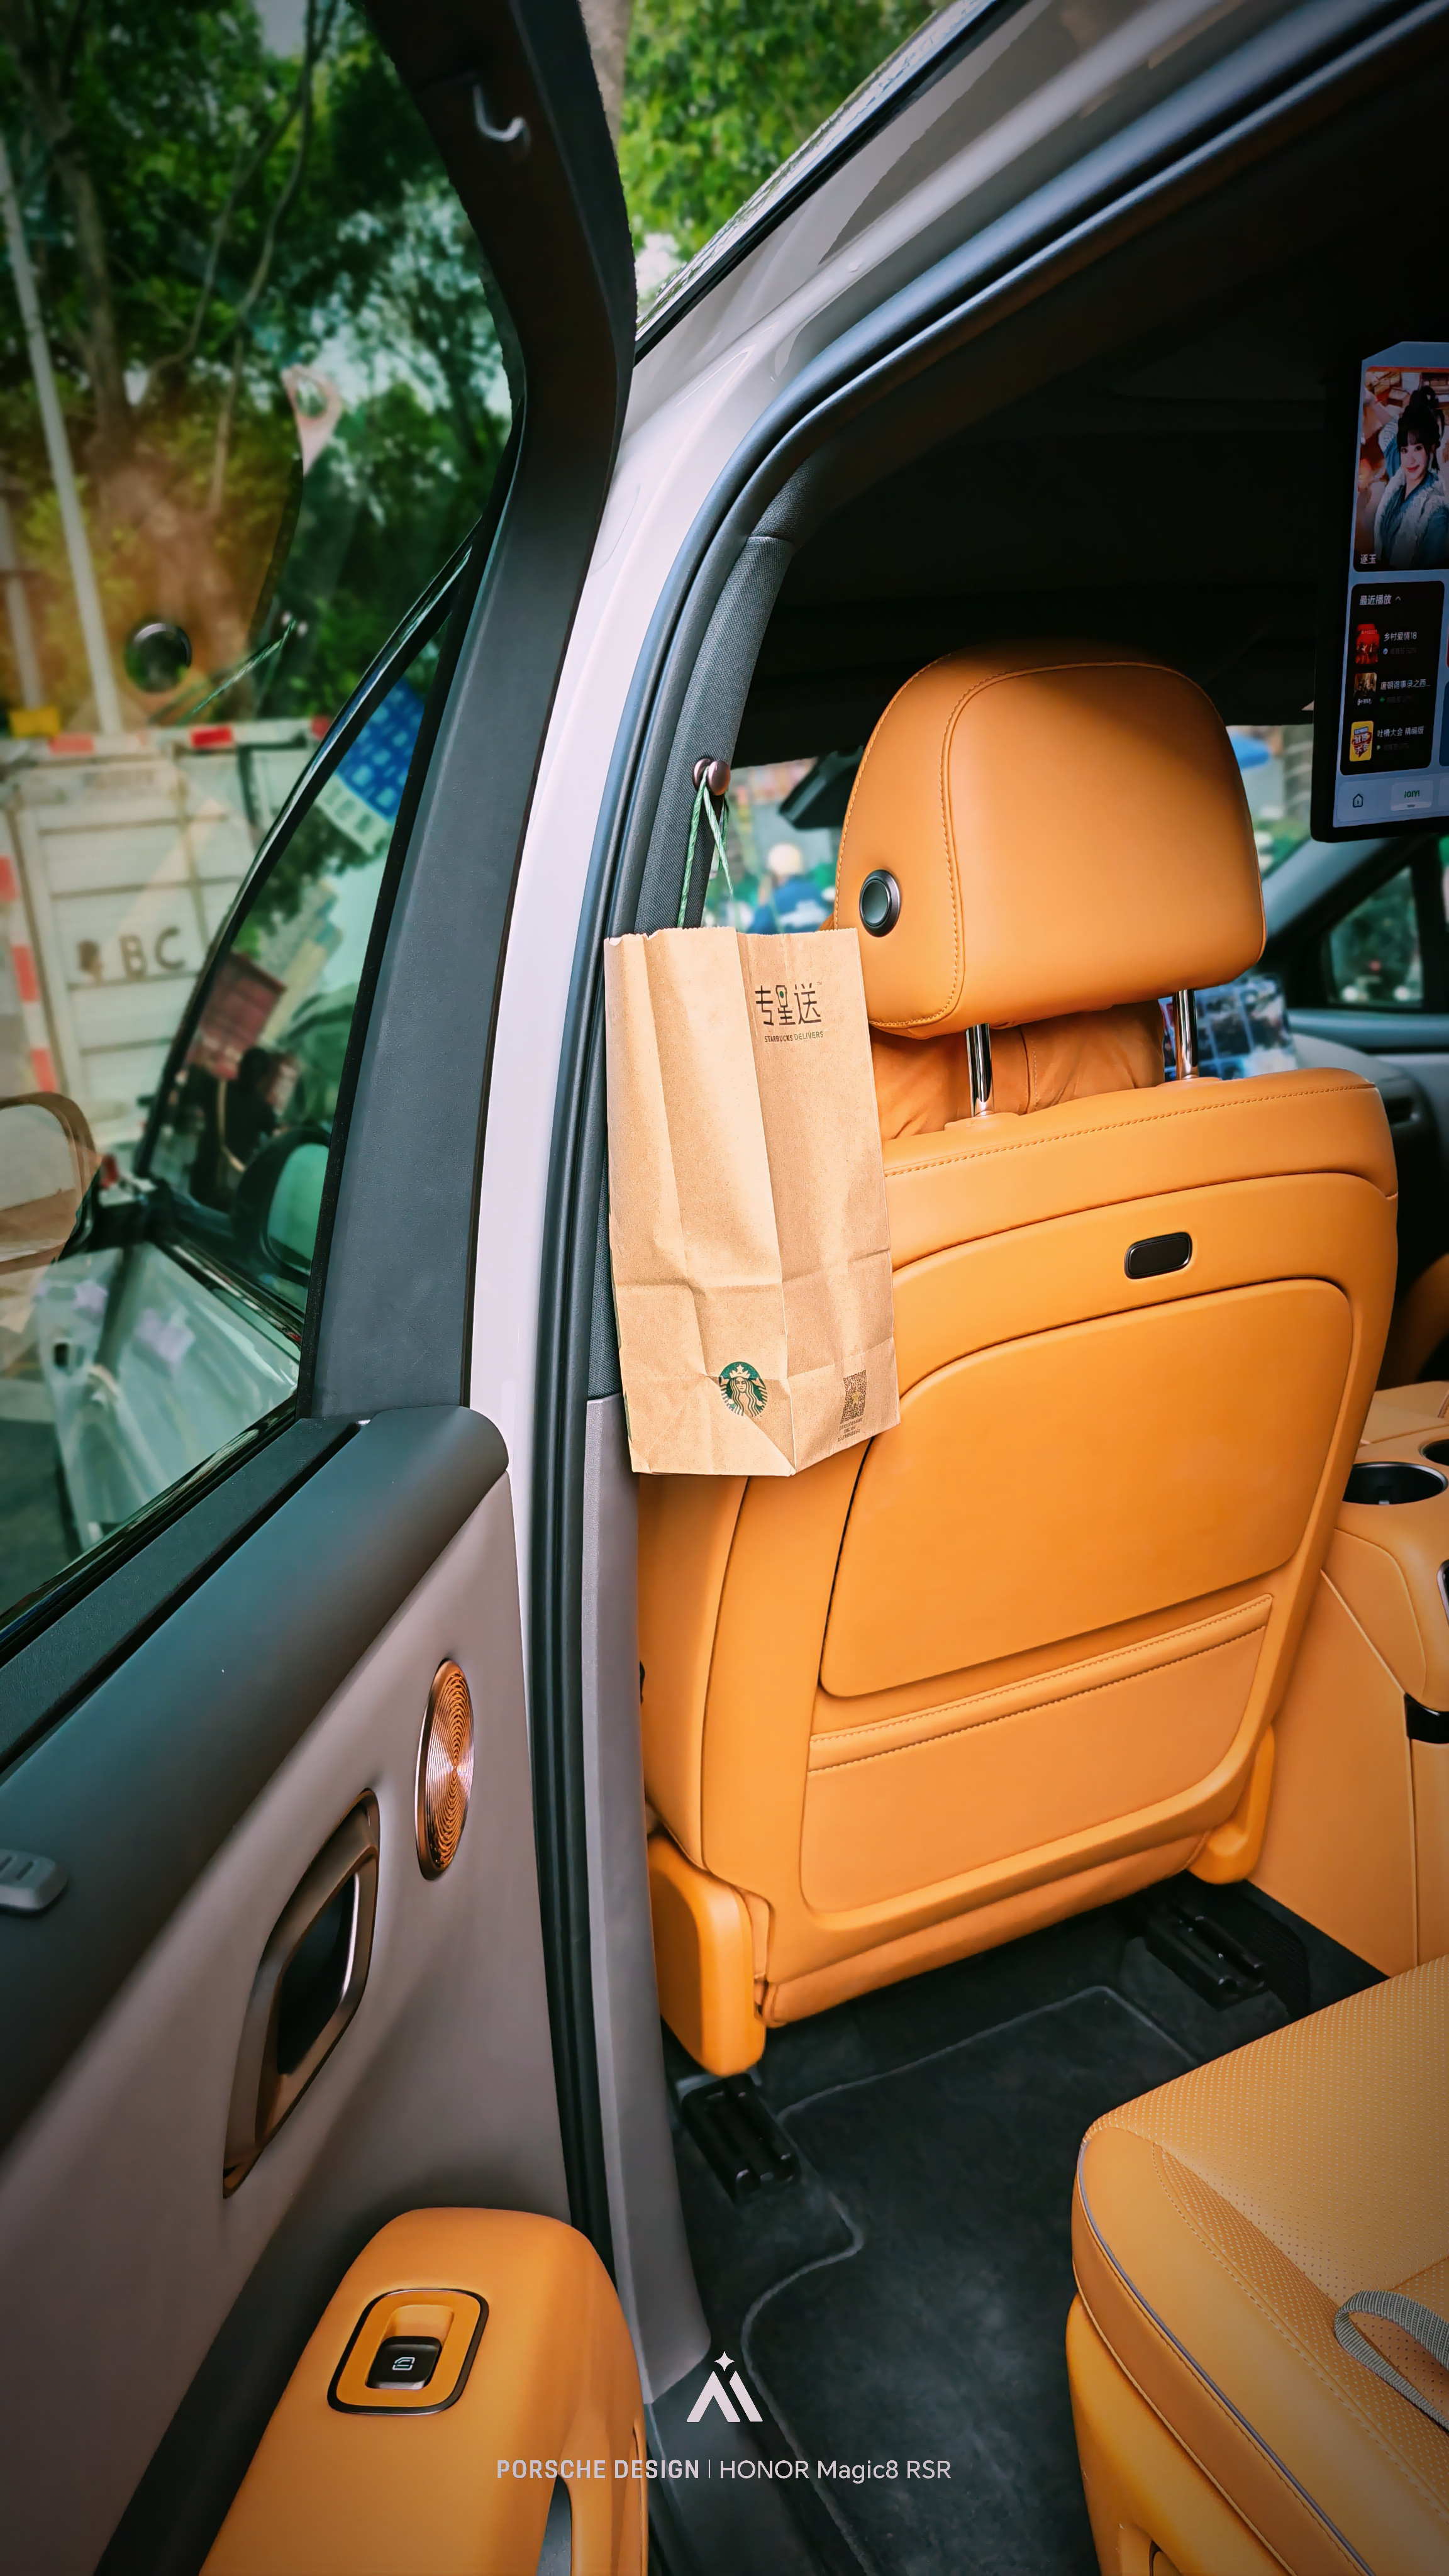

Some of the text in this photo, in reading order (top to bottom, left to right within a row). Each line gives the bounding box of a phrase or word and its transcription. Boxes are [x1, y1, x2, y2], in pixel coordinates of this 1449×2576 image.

[1359, 594, 1392, 606] 最近播放
[1383, 631, 1417, 641] 乡村爱情18
[1377, 728, 1403, 738] 吐槽大会
[764, 1031, 824, 1043] STARBUCKS DELIVERS
